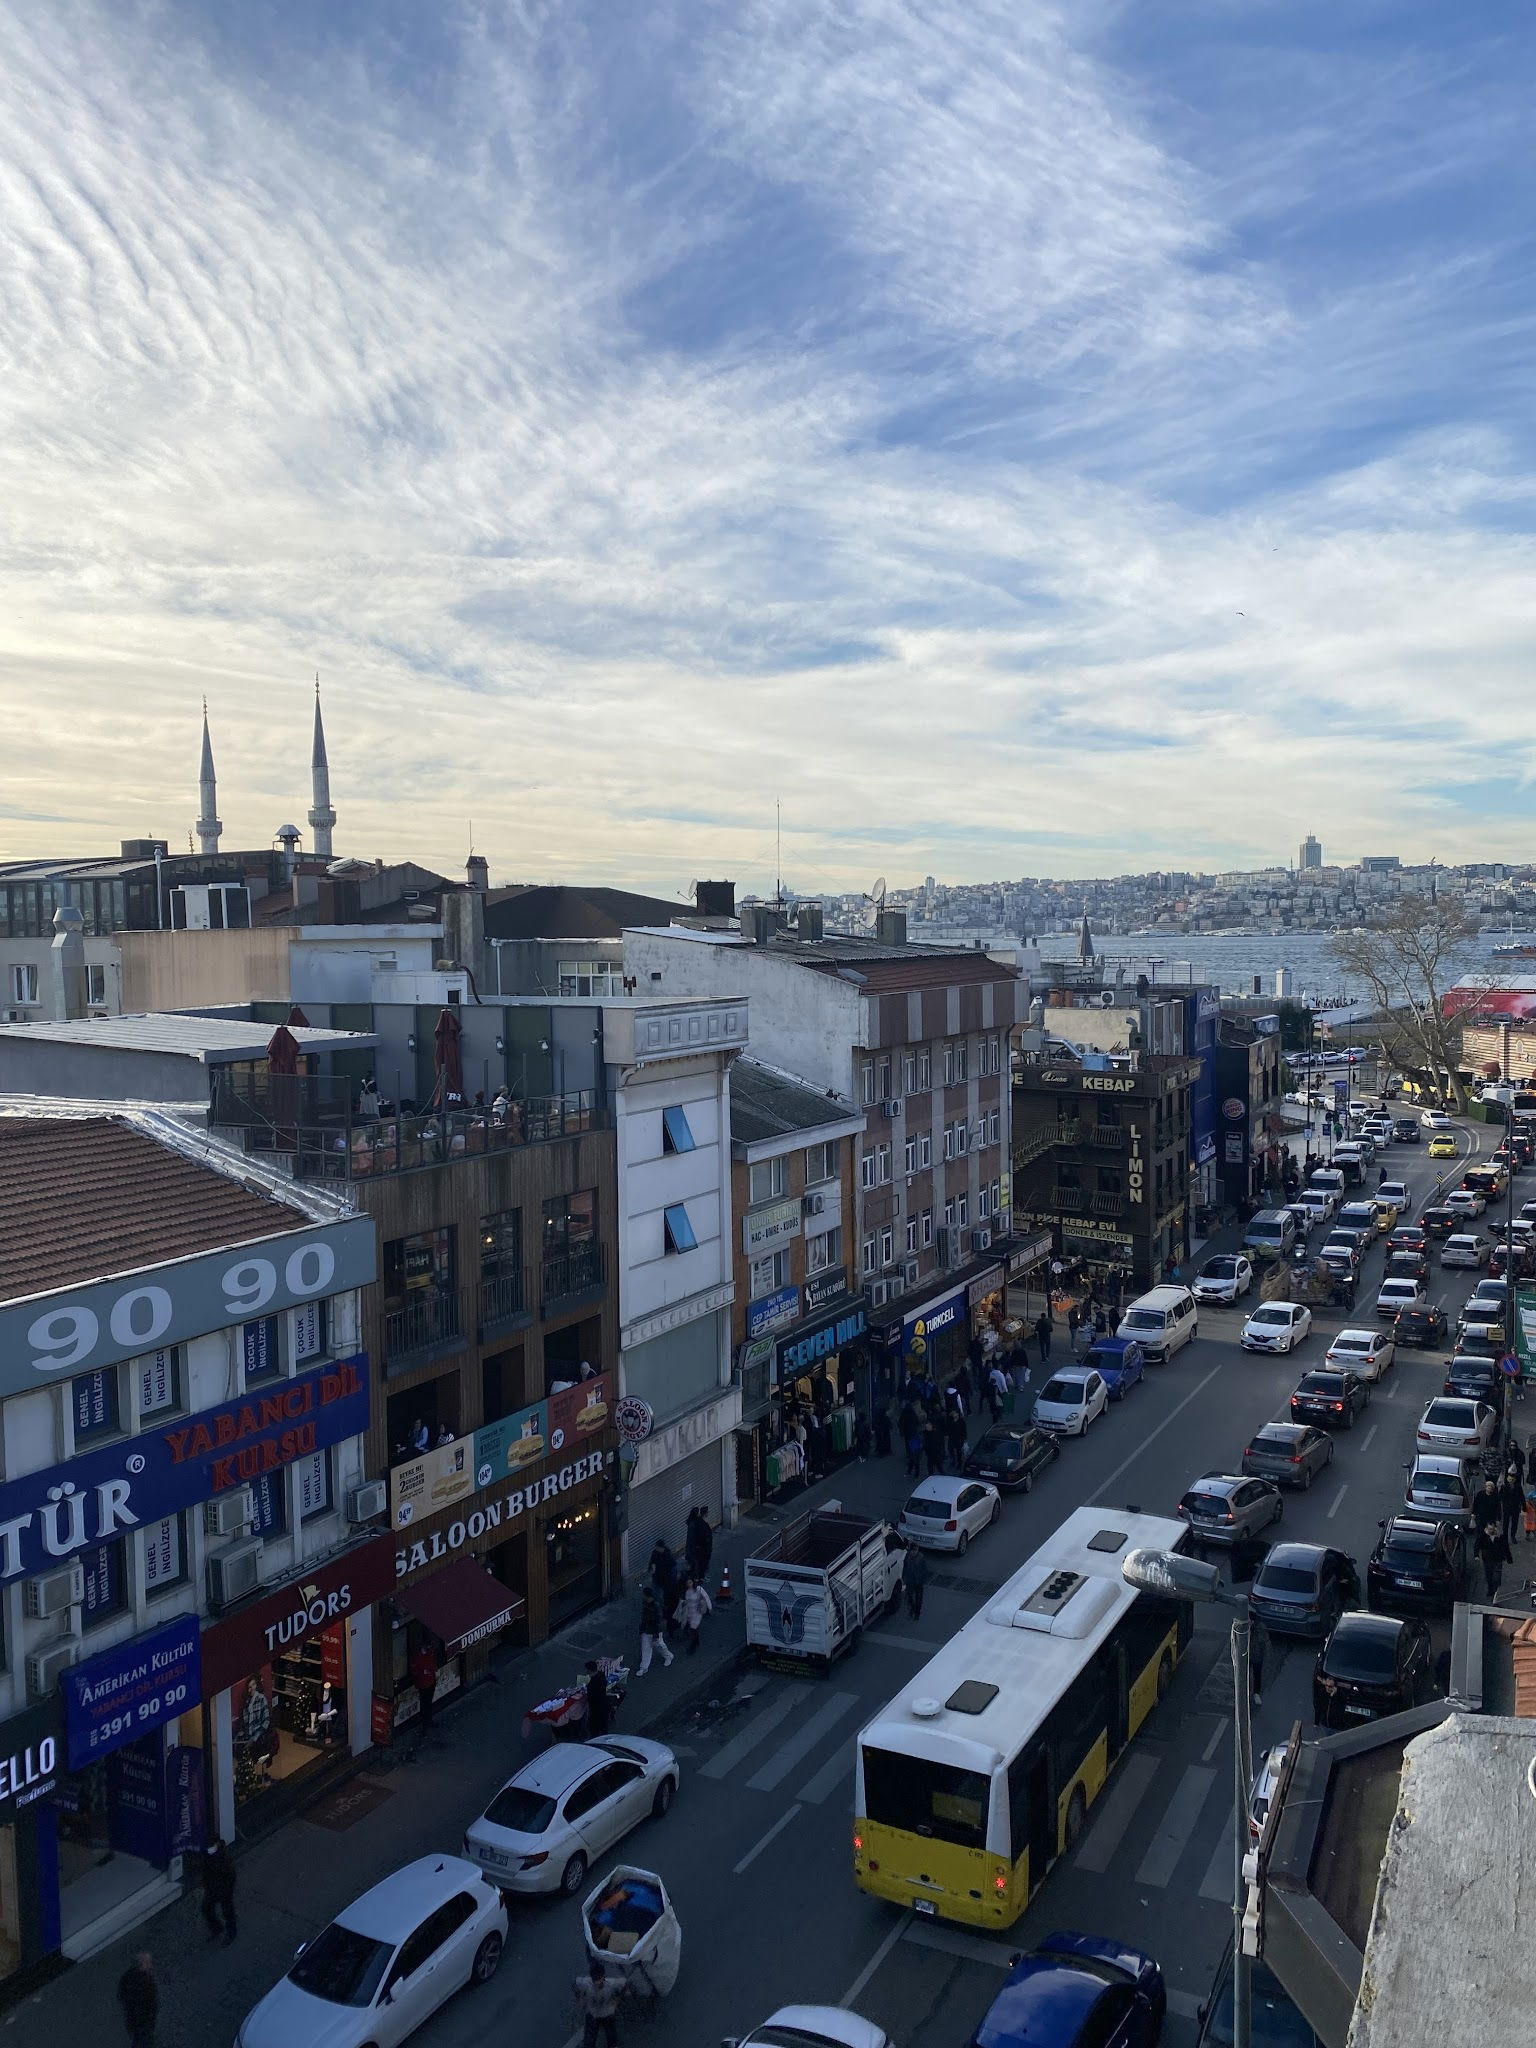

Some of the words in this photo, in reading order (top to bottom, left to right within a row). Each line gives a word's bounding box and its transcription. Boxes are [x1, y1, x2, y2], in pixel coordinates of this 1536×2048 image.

[1082, 1077, 1135, 1092] KEBAP
[1129, 1124, 1143, 1203] LİMON
[1062, 1217, 1096, 1229] KEBAP
[1099, 1220, 1116, 1231] EVİ
[27, 1286, 173, 1371] 90
[221, 1242, 335, 1315] 90
[926, 1307, 955, 1335] TURKCELL
[789, 1326, 834, 1372] SEVEN
[80, 1389, 90, 1428] GENEL
[165, 1383, 313, 1465] YABANCI
[321, 1362, 363, 1407] DİL
[617, 1400, 648, 1423] SALOON
[212, 1421, 318, 1493] KURSU
[303, 1475, 311, 1509] GENEL
[395, 1500, 502, 1578] SALOON
[506, 1451, 604, 1520] BURGER
[148, 1543, 157, 1580] GENEL
[264, 1584, 352, 1651] TUDORS
[461, 1611, 512, 1649] DONDURMA
[82, 1663, 147, 1707] AMERİKAN
[152, 1641, 195, 1672] KÜLTÜR
[100, 1711, 131, 1741] 391
[138, 1697, 160, 1720] 90
[165, 1684, 187, 1707] 90
